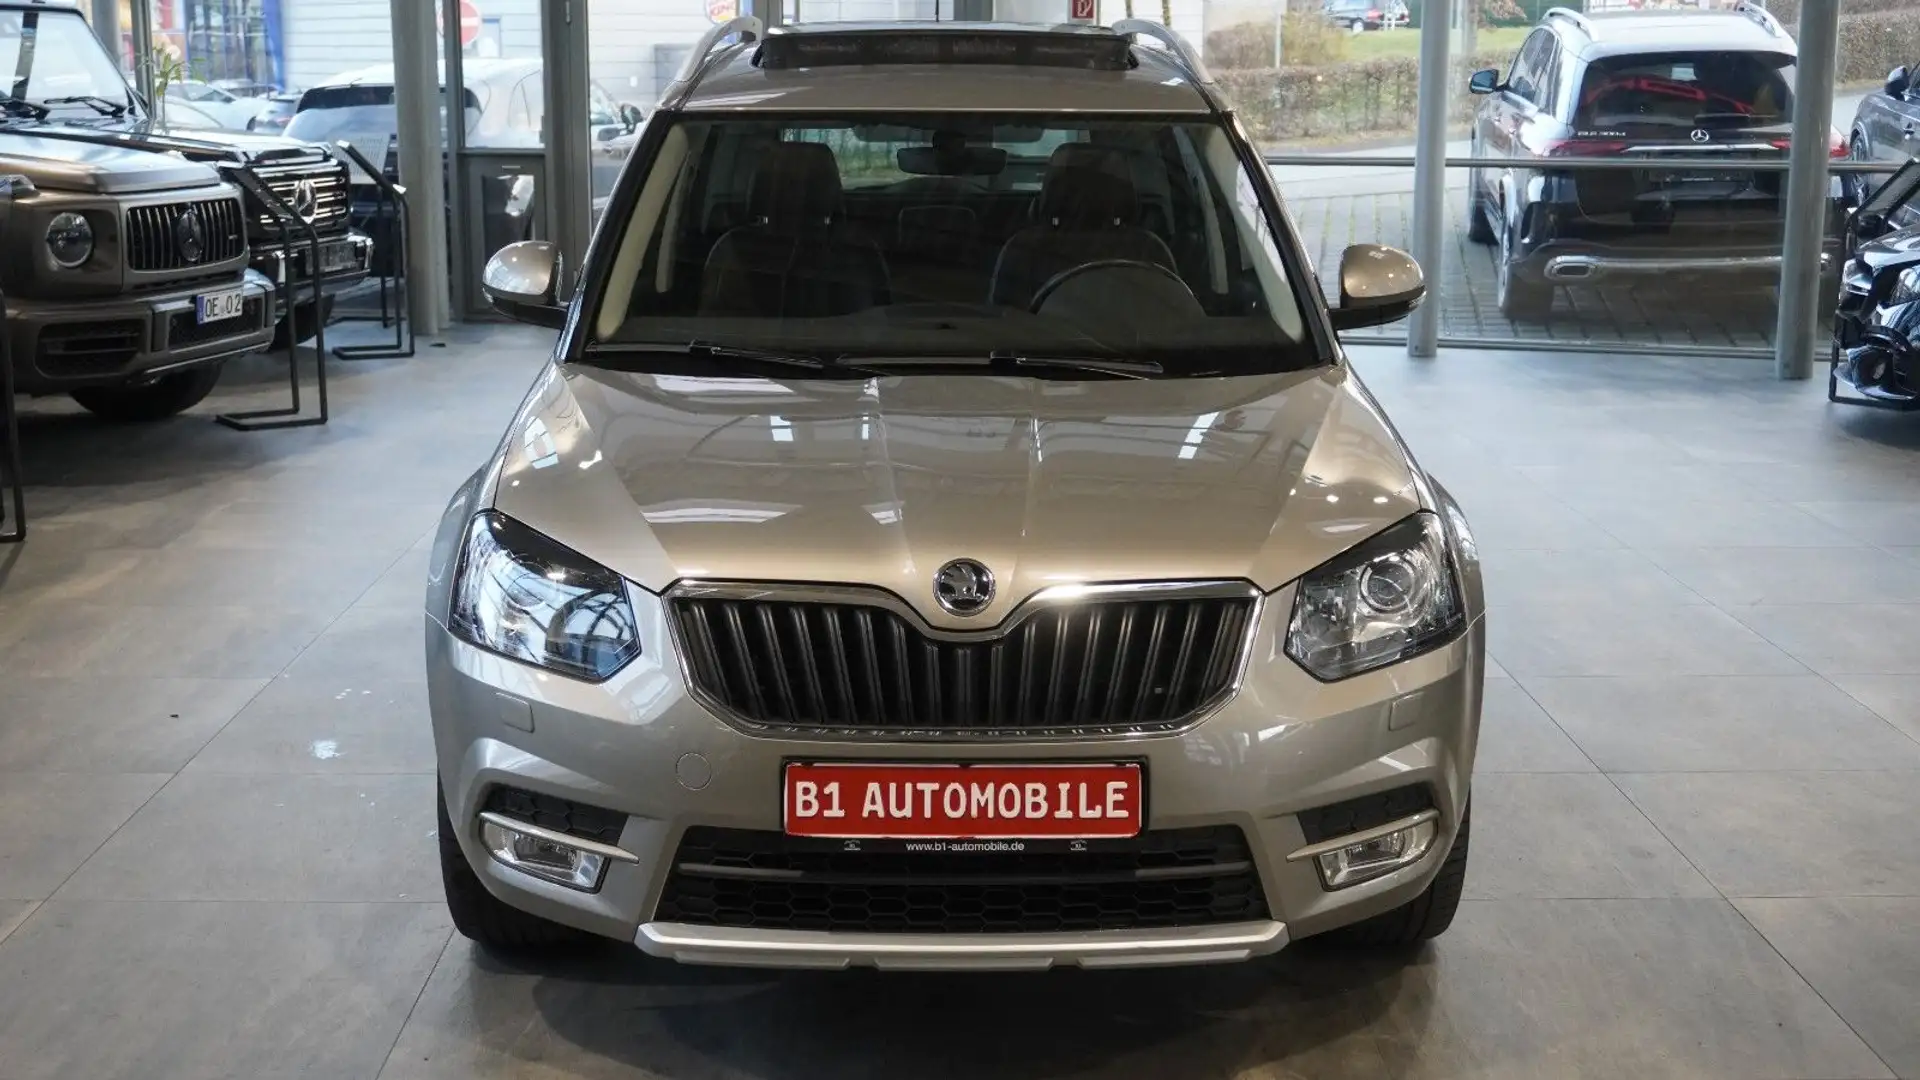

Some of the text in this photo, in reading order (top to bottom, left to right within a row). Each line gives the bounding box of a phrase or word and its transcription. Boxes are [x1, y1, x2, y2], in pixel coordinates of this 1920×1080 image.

[795, 781, 1129, 818] B1 AUTOMOBILE
[906, 841, 1025, 852] www.b1-automobile.de
